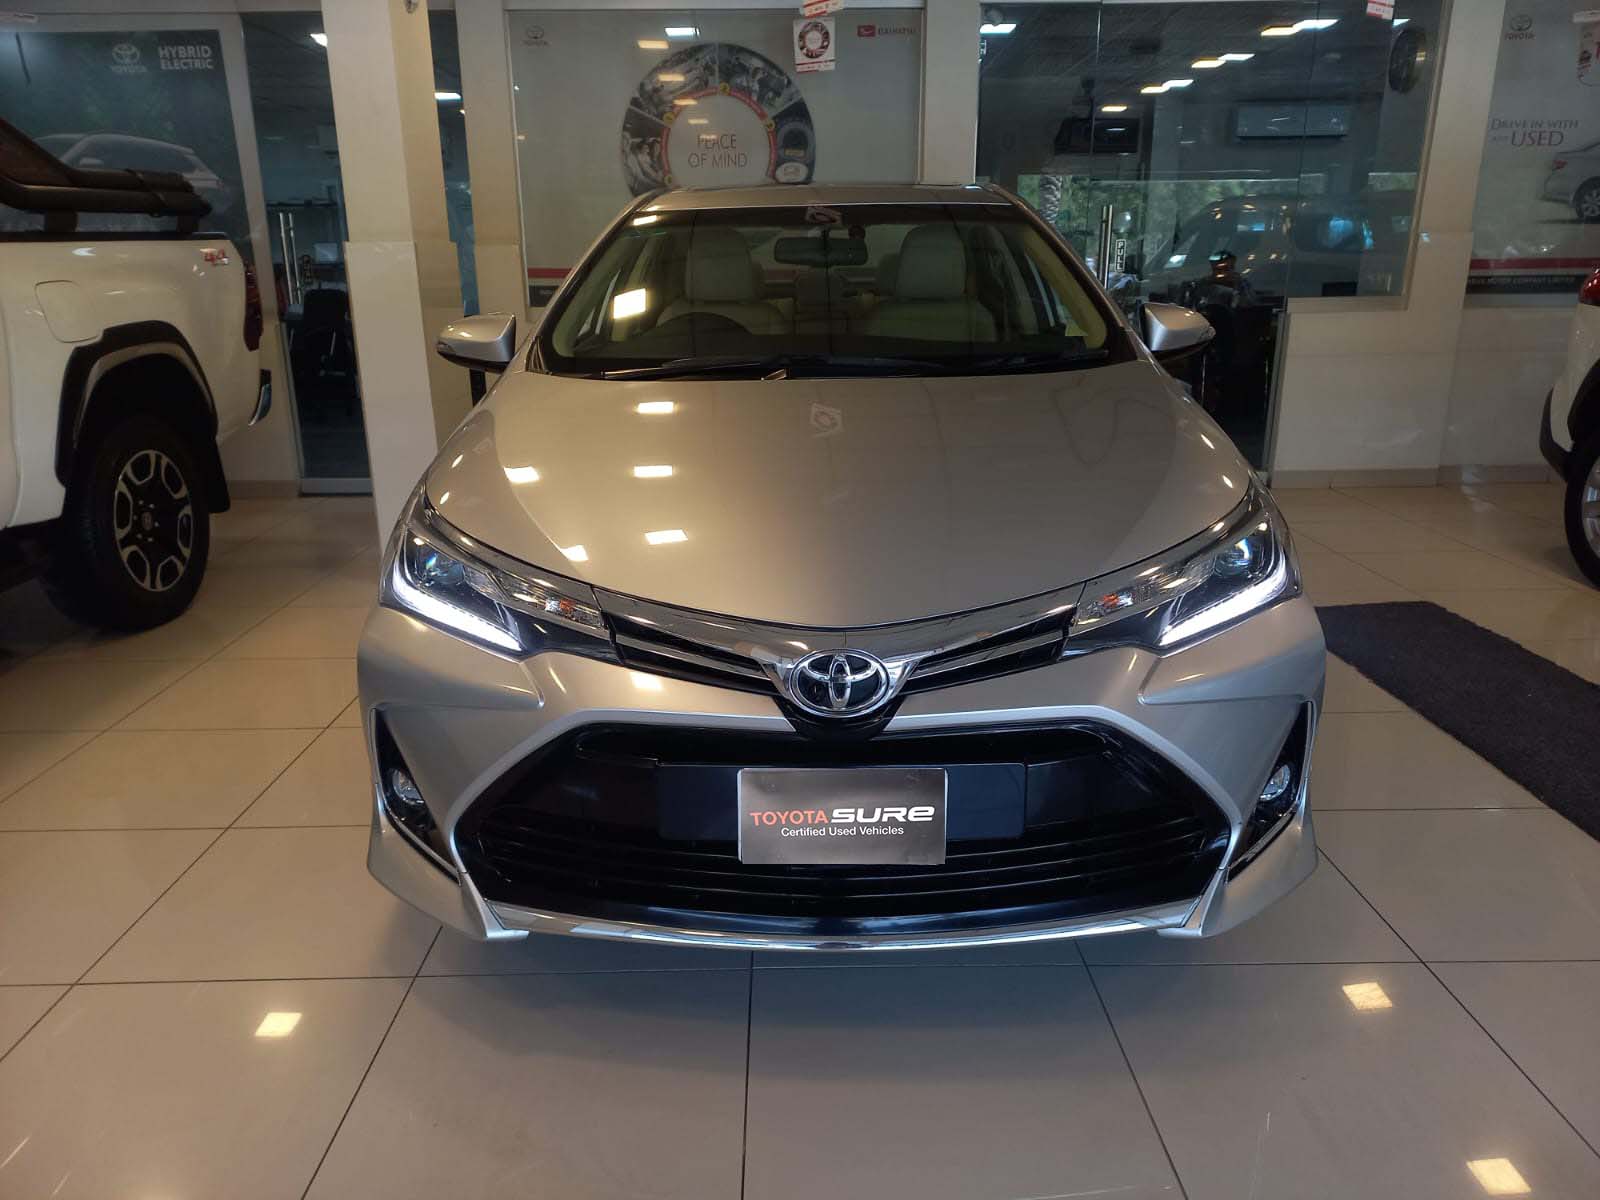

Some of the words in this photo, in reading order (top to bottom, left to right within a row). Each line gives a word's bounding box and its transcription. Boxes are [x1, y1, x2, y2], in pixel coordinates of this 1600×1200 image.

[158, 45, 212, 58] HYBRID
[160, 59, 214, 70] ELECTRIC
[1547, 119, 1579, 129] WITH
[697, 134, 737, 149] PEACE
[1511, 130, 1564, 147] USED
[688, 153, 707, 168] OF
[712, 152, 748, 168] MIND
[1116, 241, 1124, 270] PULL
[751, 810, 829, 826] TOYOTA
[781, 826, 826, 837] Certified
[829, 826, 857, 836] Used
[859, 825, 905, 836] Vehicles
